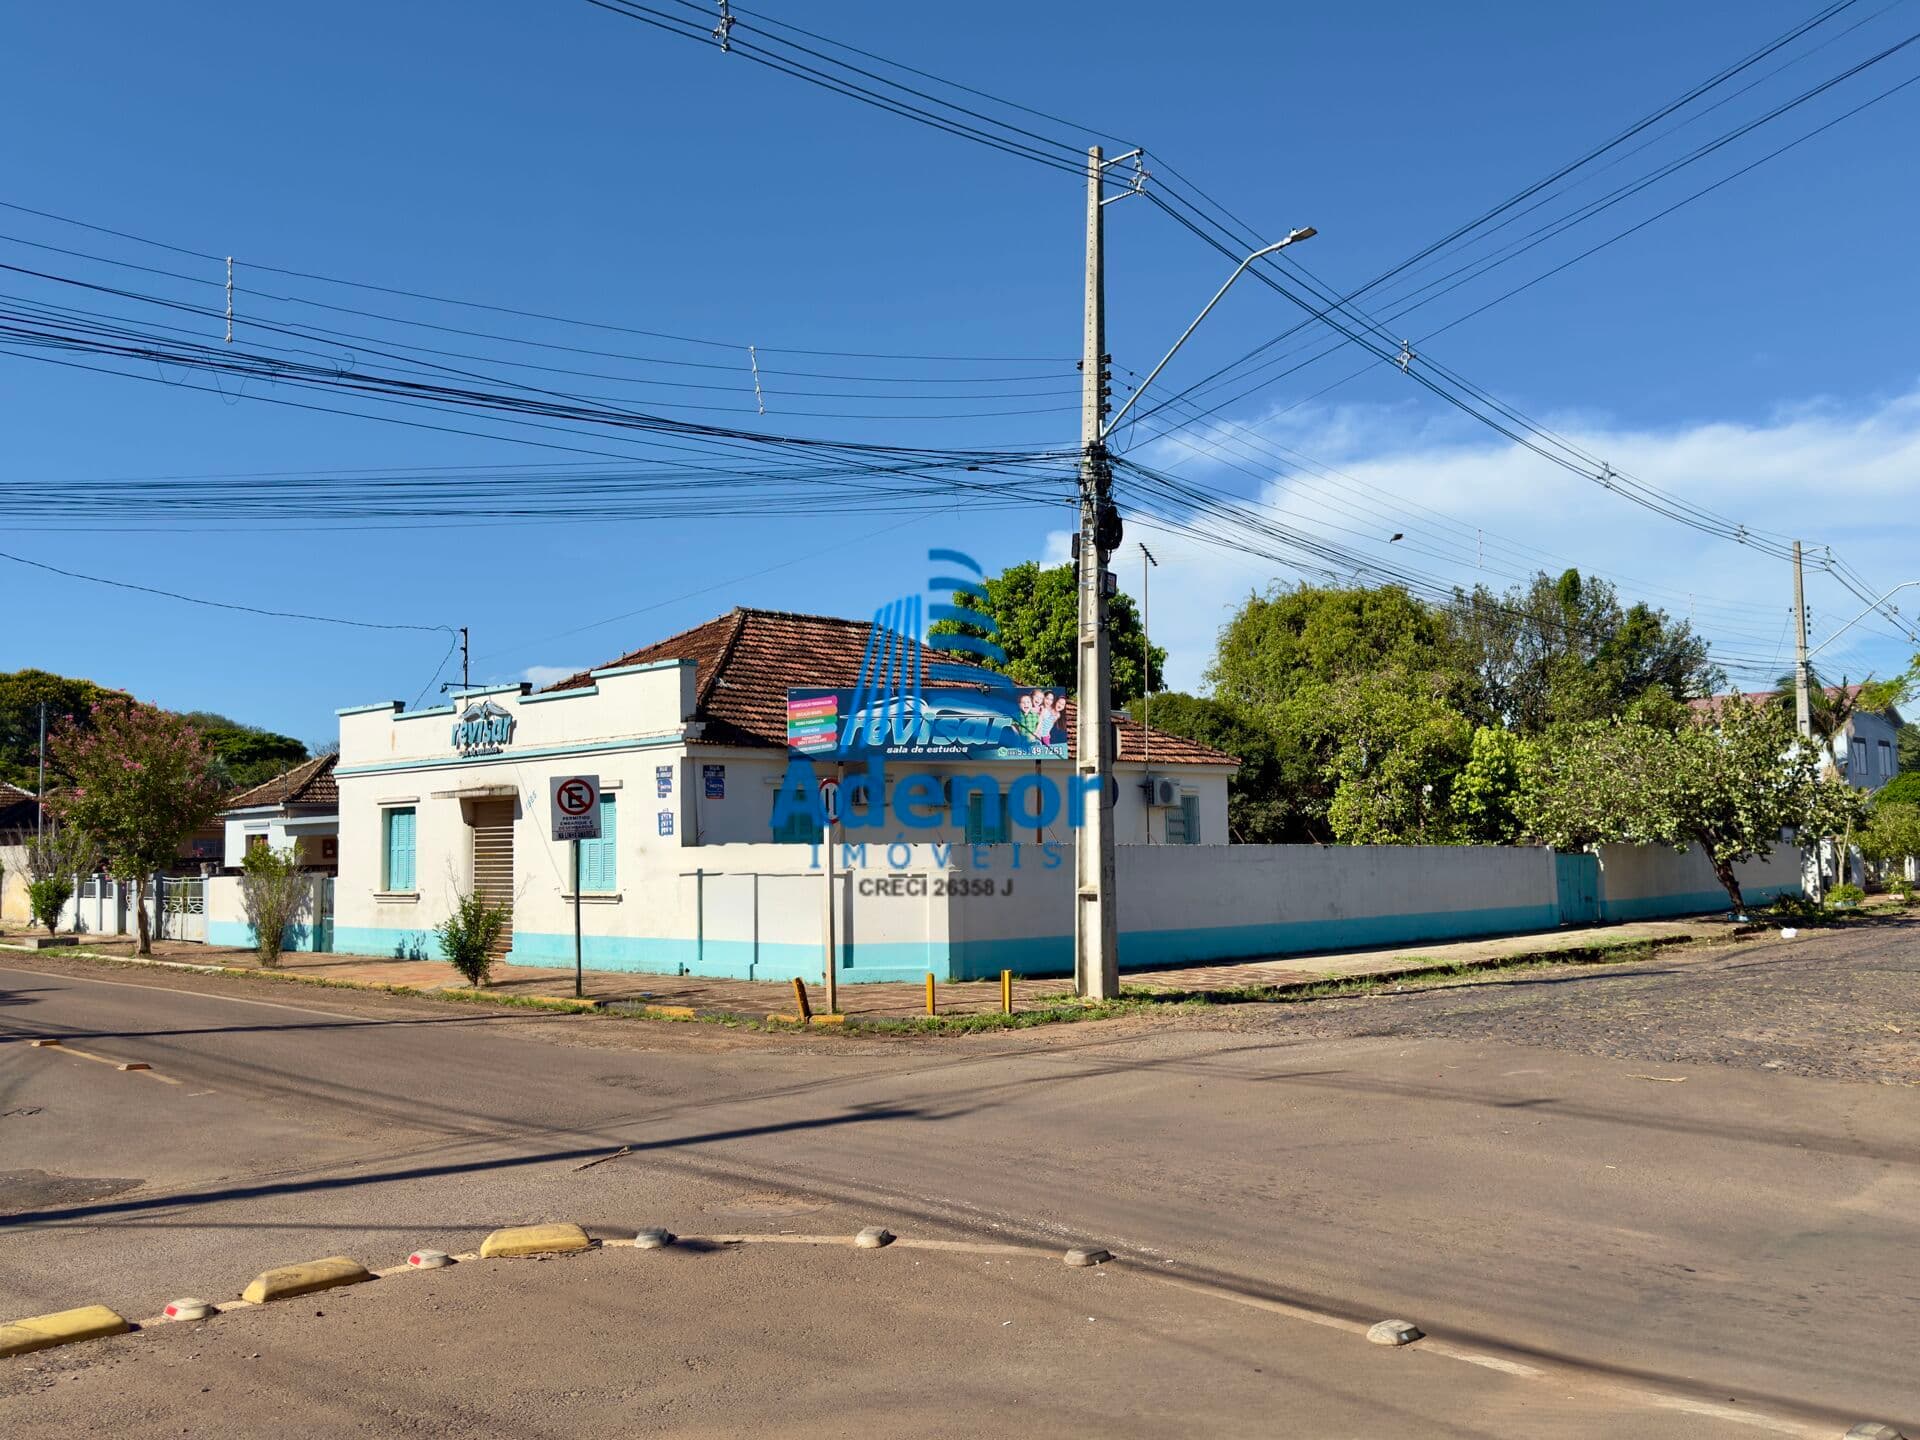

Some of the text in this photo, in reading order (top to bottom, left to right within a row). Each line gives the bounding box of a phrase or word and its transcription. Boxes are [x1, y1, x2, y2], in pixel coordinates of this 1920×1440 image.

[451, 715, 512, 746] revisar
[840, 715, 1014, 746] revisar
[886, 745, 969, 754] sala de estudos
